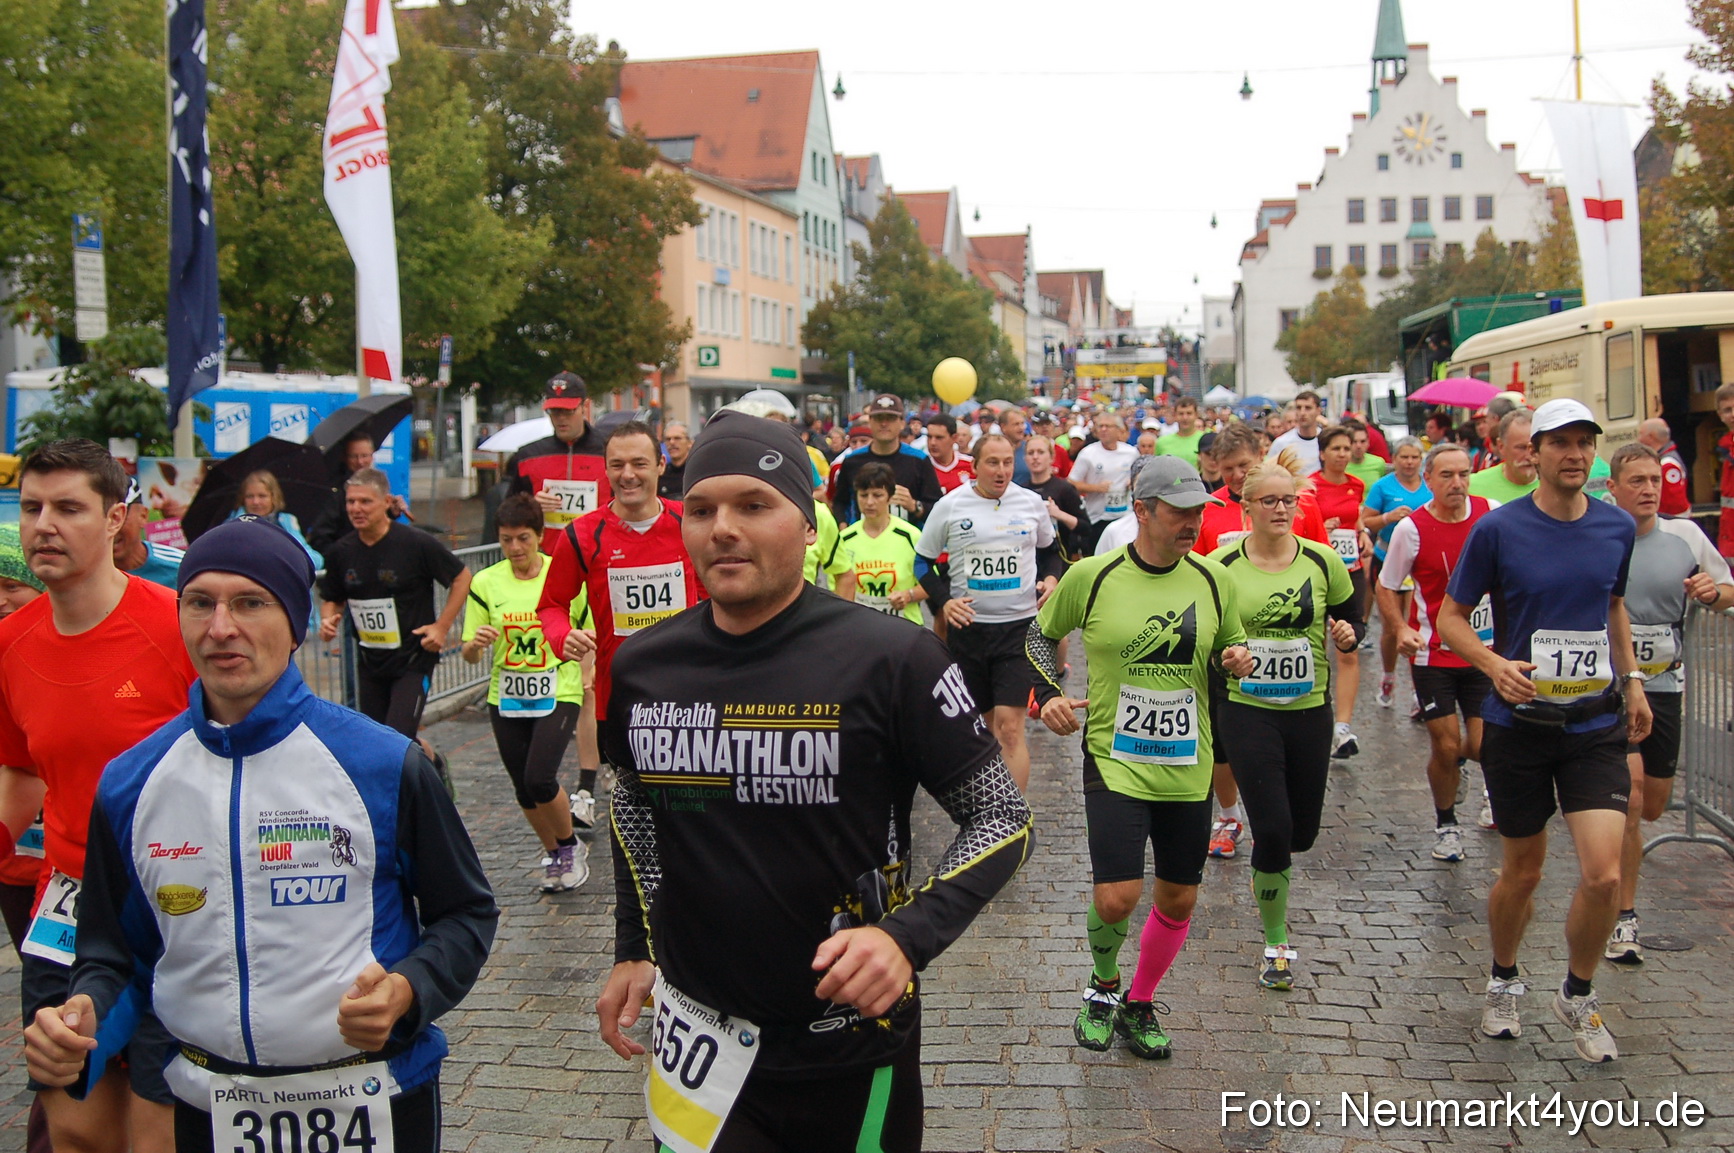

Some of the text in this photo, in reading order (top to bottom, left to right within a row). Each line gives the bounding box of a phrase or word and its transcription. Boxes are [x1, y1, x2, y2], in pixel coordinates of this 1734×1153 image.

[700, 347, 718, 366] D
[215, 408, 250, 431] DIXI
[271, 410, 306, 431] DIXI
[855, 560, 896, 570] Müller
[971, 555, 1017, 577] 2646
[609, 571, 673, 582] PARTL Neumarkt
[626, 582, 673, 610] 504
[359, 611, 386, 630] 150
[1247, 599, 1280, 627] GOSSEN
[515, 636, 537, 656] M
[1120, 623, 1159, 659] GOSSEN
[1533, 637, 1601, 646] PARTL Neumarkt
[1128, 667, 1193, 678] METRAWATT
[1248, 655, 1308, 680] 2460
[1551, 650, 1597, 677] 179
[505, 676, 551, 697] 2068
[1253, 685, 1301, 696] Alexandra
[1551, 683, 1589, 695] Marcus
[1120, 690, 1184, 707] PARTL Neumarkt
[724, 703, 841, 716] HAMBURG 2012
[1123, 704, 1191, 737] 2459
[628, 728, 840, 776] URBANATHLON
[1134, 741, 1176, 755] Herbert
[736, 776, 840, 804] & FESTIVAL
[258, 815, 330, 825] Windischeschenbach
[259, 808, 309, 818] RSV Concordia
[258, 822, 331, 844] PANORAMA
[147, 841, 204, 860] Bergler
[259, 842, 293, 863] TOUR
[259, 861, 319, 872] Oberpfälzer Wald
[57, 930, 76, 948] An
[653, 1001, 719, 1090] 550
[215, 1084, 355, 1104] PARTL Neumarkt
[232, 1105, 377, 1153] 3084
